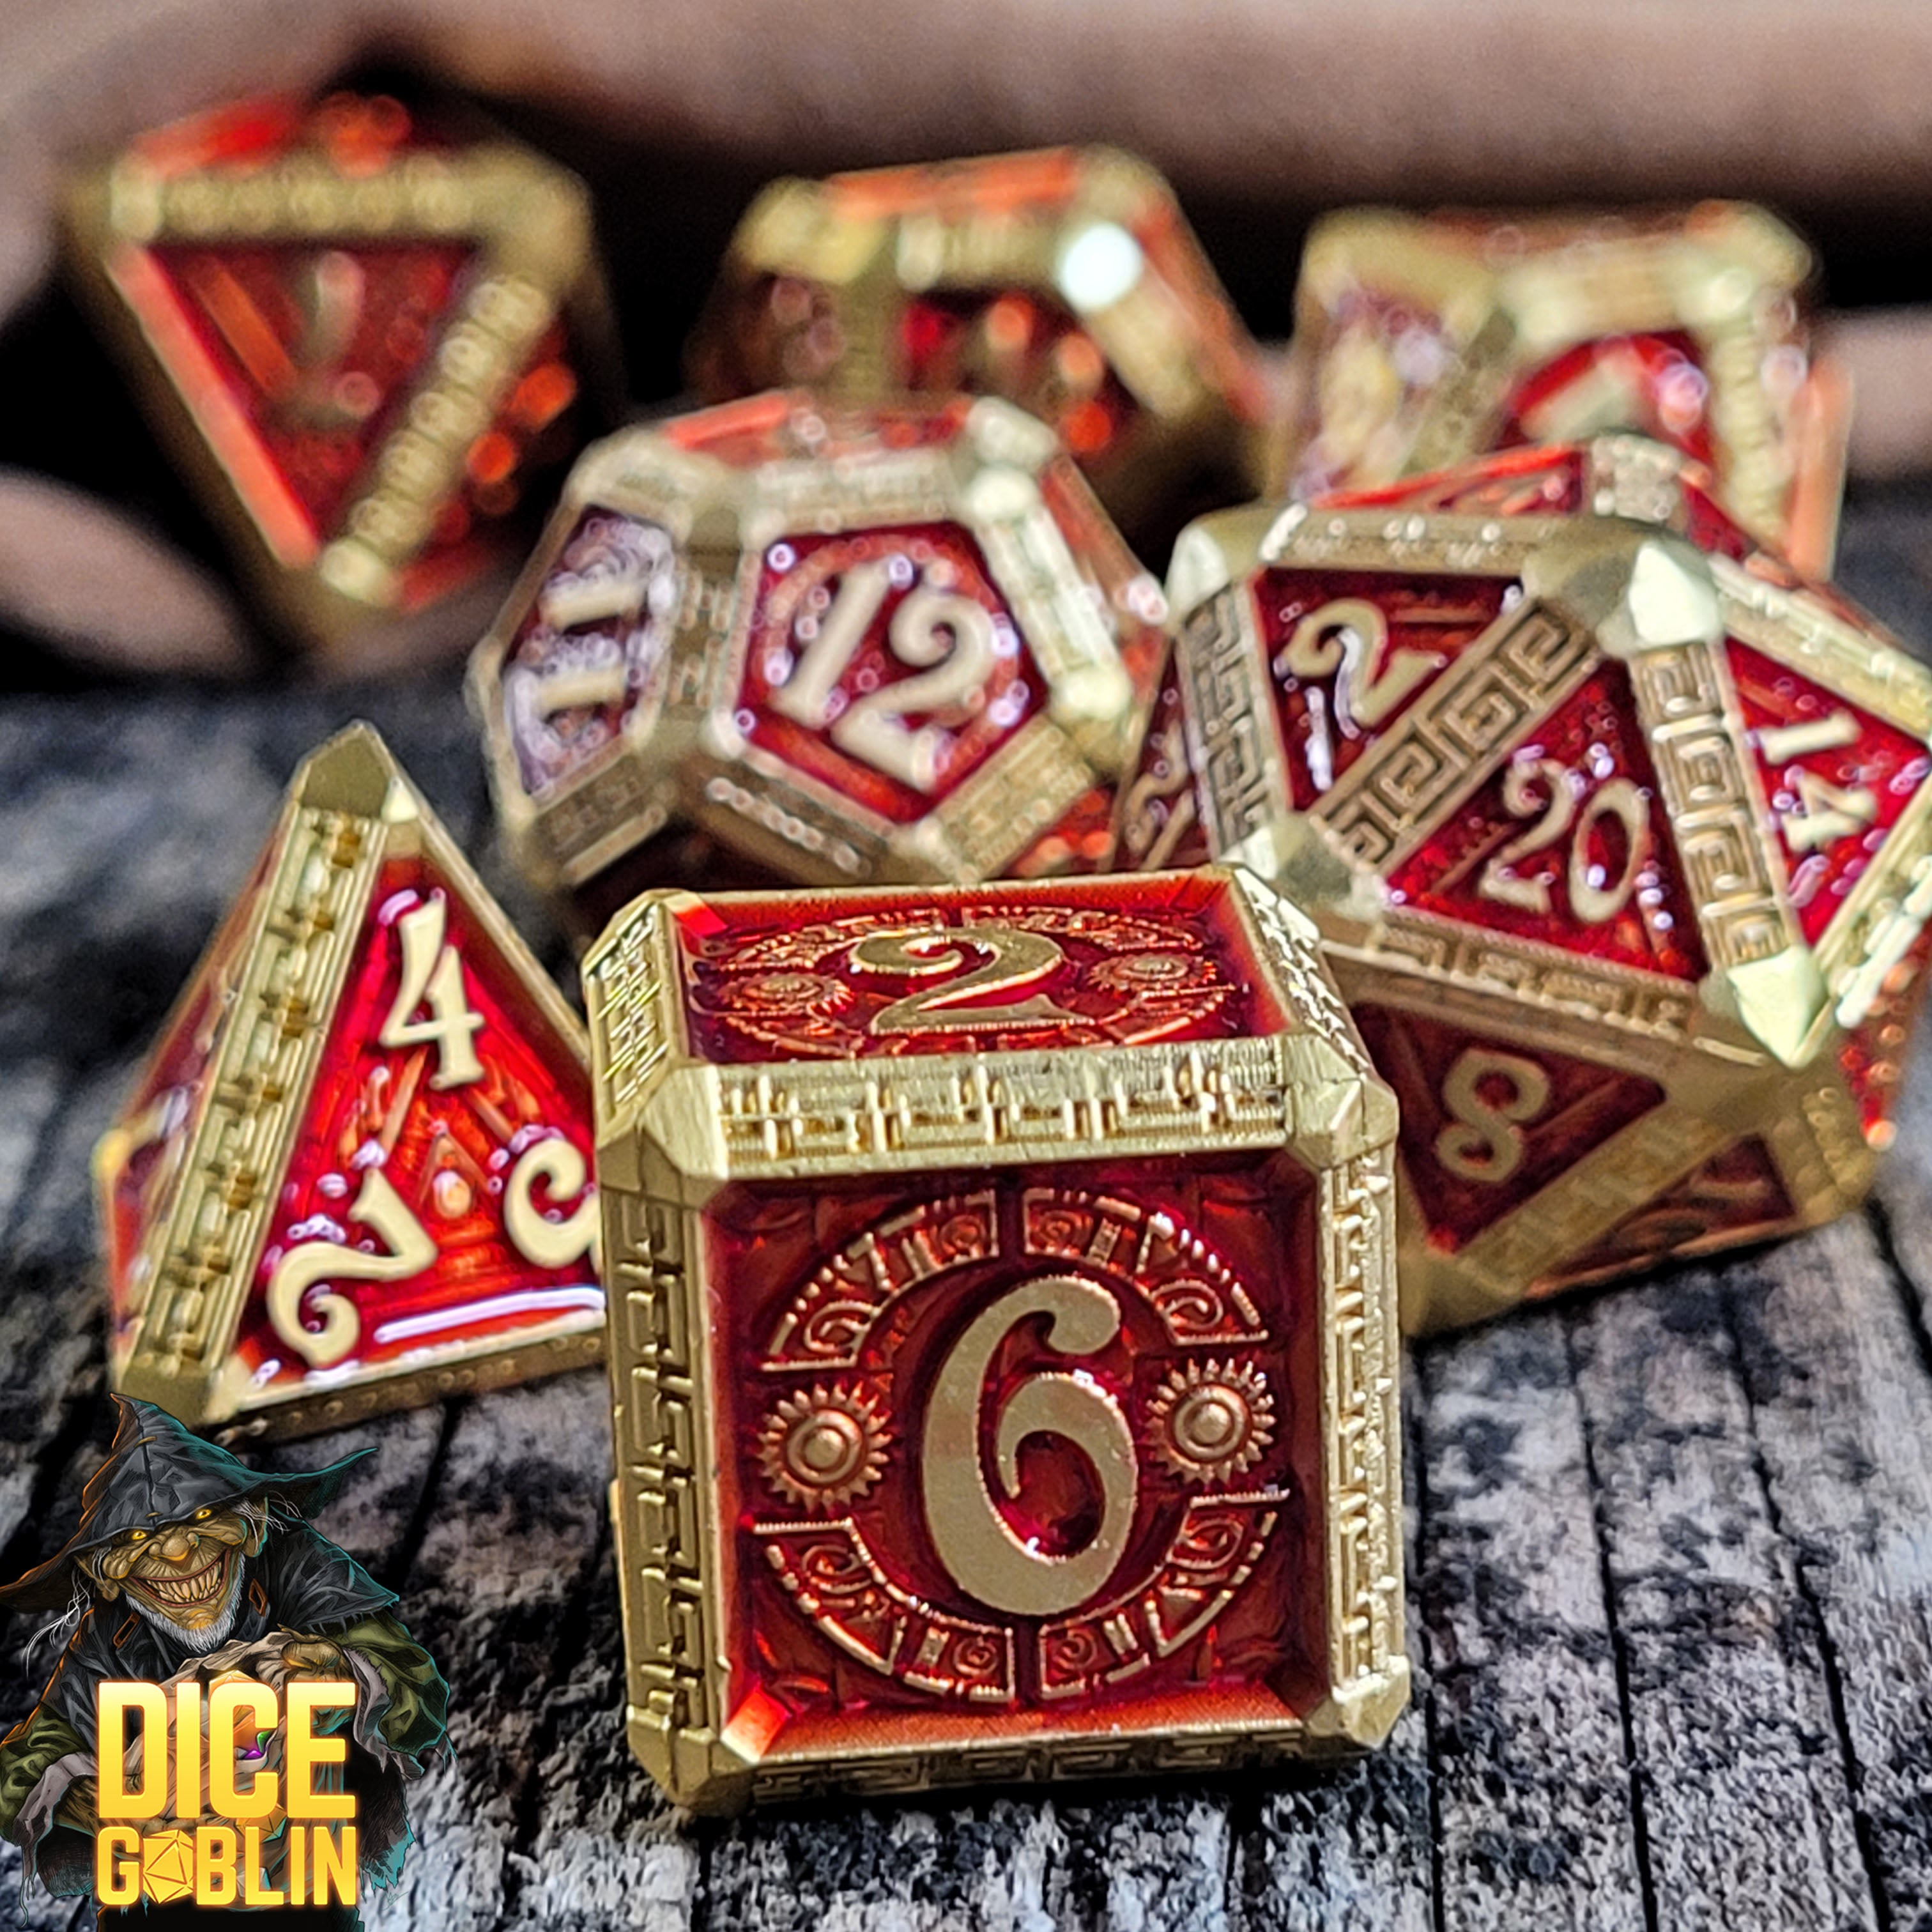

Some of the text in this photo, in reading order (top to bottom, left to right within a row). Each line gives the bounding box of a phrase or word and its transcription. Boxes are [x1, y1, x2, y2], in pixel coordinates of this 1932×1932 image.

[770, 555, 1001, 792] 12
[1479, 747, 1651, 923] 20
[1745, 706, 1873, 853] 14
[379, 892, 486, 1090] 4
[848, 926, 1094, 1032] 2
[1435, 1048, 1551, 1183] 8
[266, 1167, 440, 1366] 2
[922, 1275, 1138, 1615] 6
